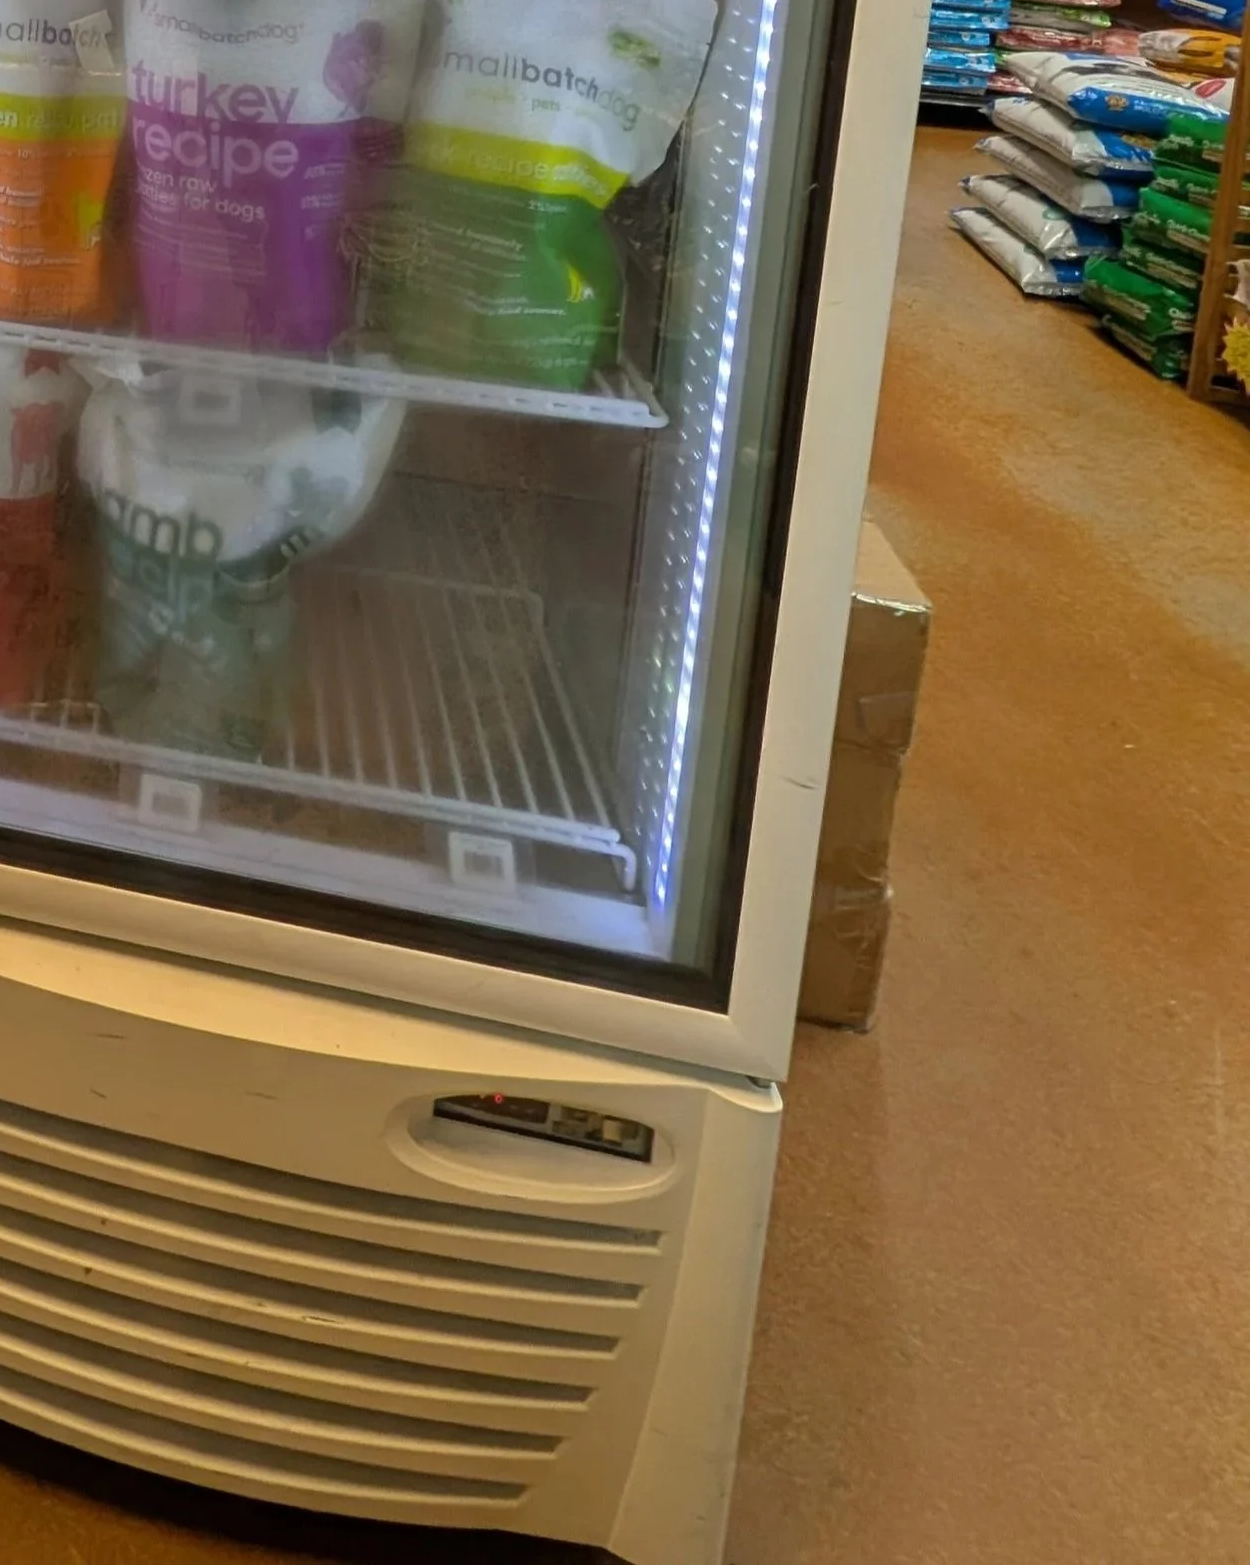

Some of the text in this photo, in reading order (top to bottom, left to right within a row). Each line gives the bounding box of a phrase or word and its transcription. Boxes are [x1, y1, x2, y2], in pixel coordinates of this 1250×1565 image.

[131, 58, 300, 127] turkey
[131, 114, 300, 190] recipe
[179, 176, 218, 194] raw
[183, 190, 266, 223] for dogs
